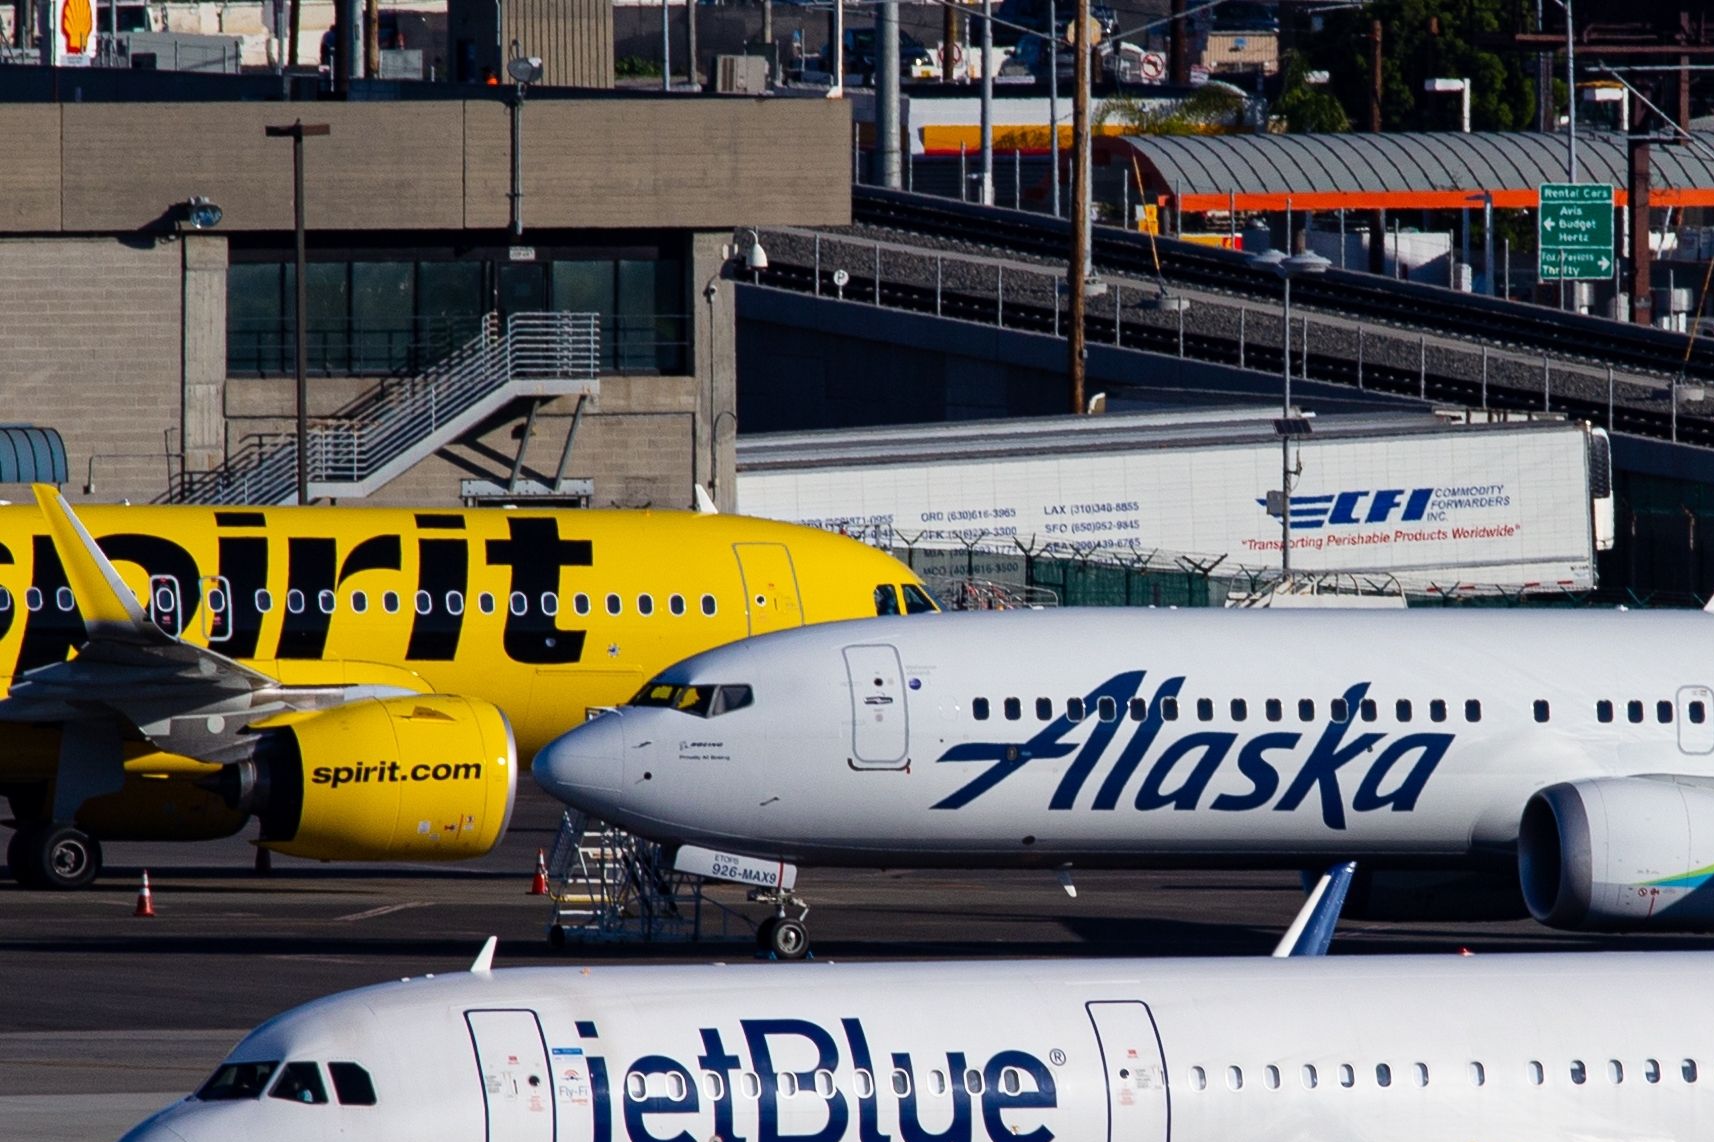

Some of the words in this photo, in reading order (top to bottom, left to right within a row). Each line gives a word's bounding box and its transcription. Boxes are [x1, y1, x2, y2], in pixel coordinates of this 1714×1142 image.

[1544, 188, 1579, 198] Rental
[1583, 188, 1608, 198] Cars
[1560, 206, 1582, 215] Avis
[1559, 219, 1596, 231] Budget
[1559, 233, 1589, 242] Hertz
[1542, 265, 1580, 276] Thrfty
[1435, 485, 1505, 498] COMMODITY
[1431, 496, 1511, 510] FORWARDERS
[1044, 505, 1066, 516] LAX
[920, 512, 944, 522] ORD
[1427, 511, 1448, 522] INC.
[1045, 524, 1067, 534] SFO
[1327, 530, 1391, 547] Perishable
[1395, 528, 1448, 542] Products
[929, 670, 1456, 830] Alaska
[312, 761, 482, 788] spirit.com
[712, 863, 777, 885] 926-MAX9
